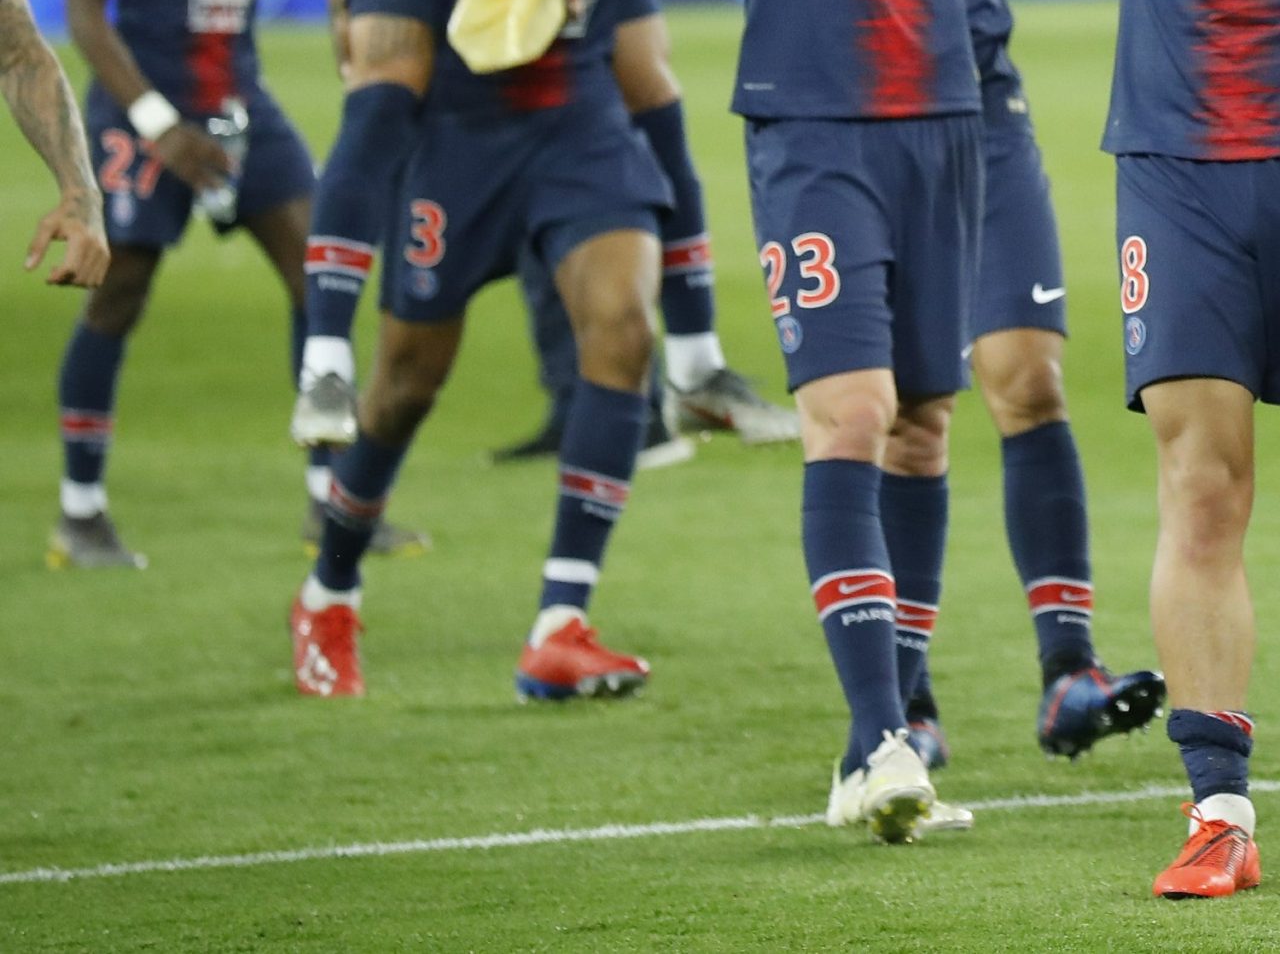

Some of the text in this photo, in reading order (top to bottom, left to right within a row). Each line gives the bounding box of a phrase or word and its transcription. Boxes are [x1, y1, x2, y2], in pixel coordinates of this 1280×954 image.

[100, 128, 164, 199] 27
[403, 197, 448, 269] 3
[760, 231, 841, 319] 23
[1120, 235, 1150, 314] 8
